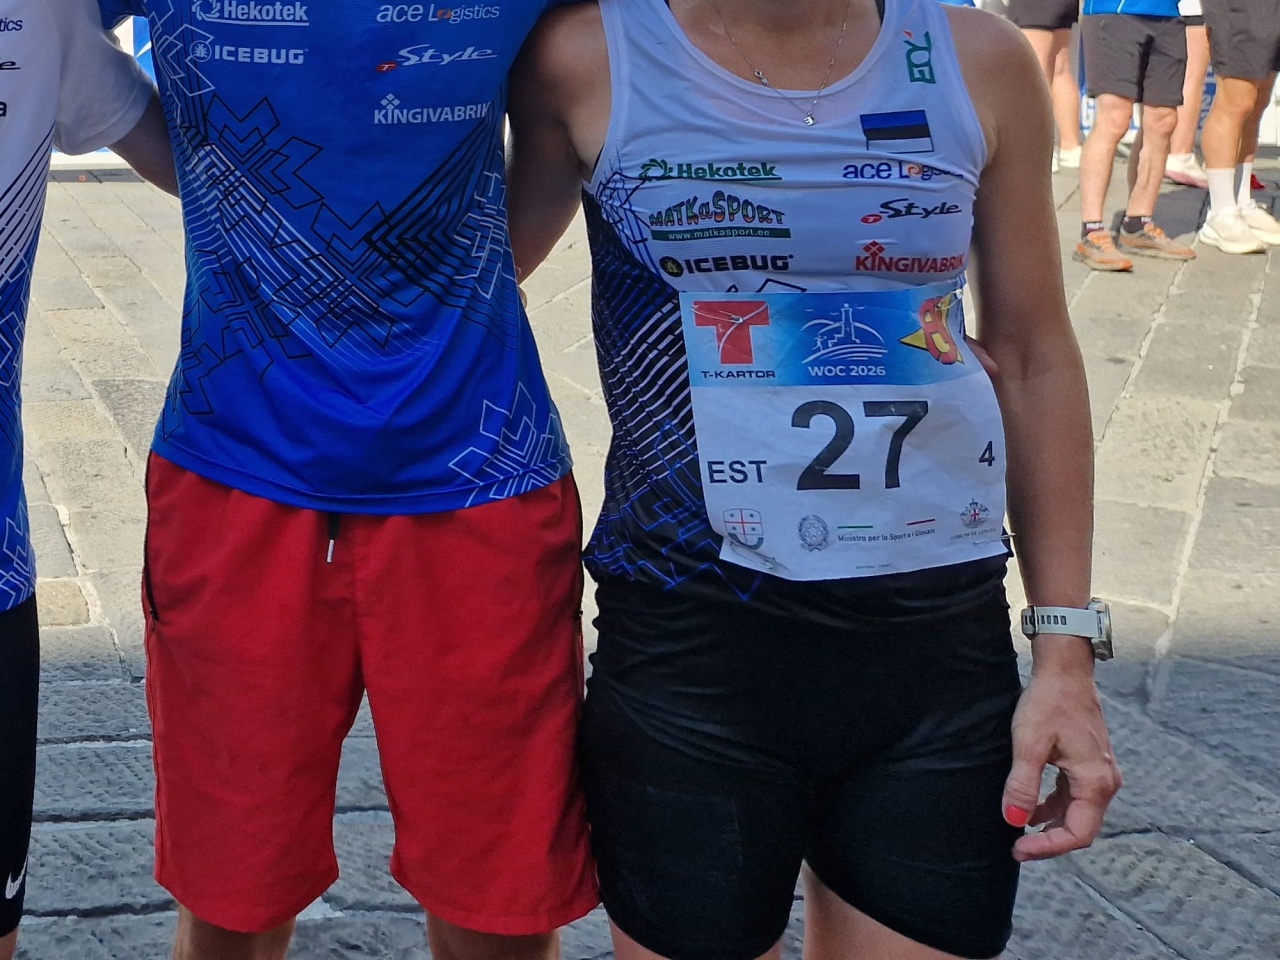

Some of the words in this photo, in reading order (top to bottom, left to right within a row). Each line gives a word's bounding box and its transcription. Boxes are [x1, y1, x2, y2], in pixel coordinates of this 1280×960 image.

[223, 0, 308, 21] Hekotek
[376, 3, 423, 22] ace
[428, 3, 500, 24] Logistics
[214, 45, 304, 65] ICEBUG
[396, 43, 498, 66] Style
[374, 101, 491, 124] KINGIVABRIK
[677, 162, 778, 179] Hekotek
[842, 162, 892, 179] ace
[878, 198, 962, 218] Style
[668, 228, 770, 240] www.matkasport.ee
[684, 255, 790, 274] ICEBUG
[701, 370, 776, 379] T-KARTOR
[808, 366, 846, 376] WOC
[849, 365, 886, 376] 2026
[791, 400, 929, 491] 27
[978, 440, 996, 467] 4
[707, 459, 767, 484] EST
[838, 534, 867, 542] Ministro
[889, 533, 907, 541] Sport
